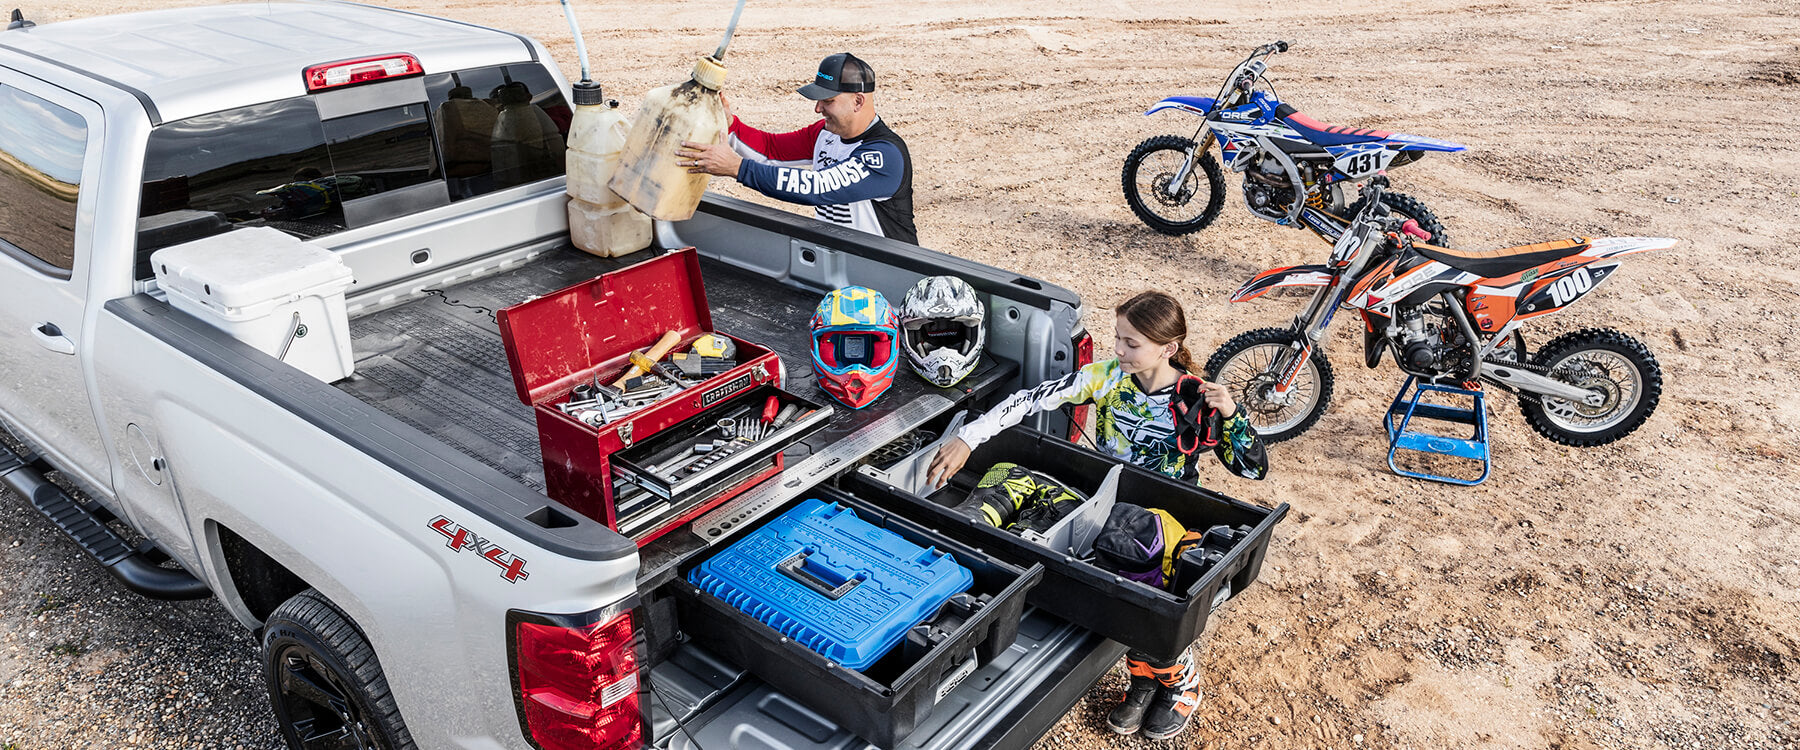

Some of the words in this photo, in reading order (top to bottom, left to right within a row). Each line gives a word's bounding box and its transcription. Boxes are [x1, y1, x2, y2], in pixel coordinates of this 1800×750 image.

[1219, 111, 1250, 120] ORE
[776, 157, 870, 195] FASTHOUSE
[1347, 150, 1383, 176] 431
[1545, 266, 1593, 308] 100
[1281, 353, 1303, 387] DUNLOP
[704, 376, 750, 404] CRAFTSMAN
